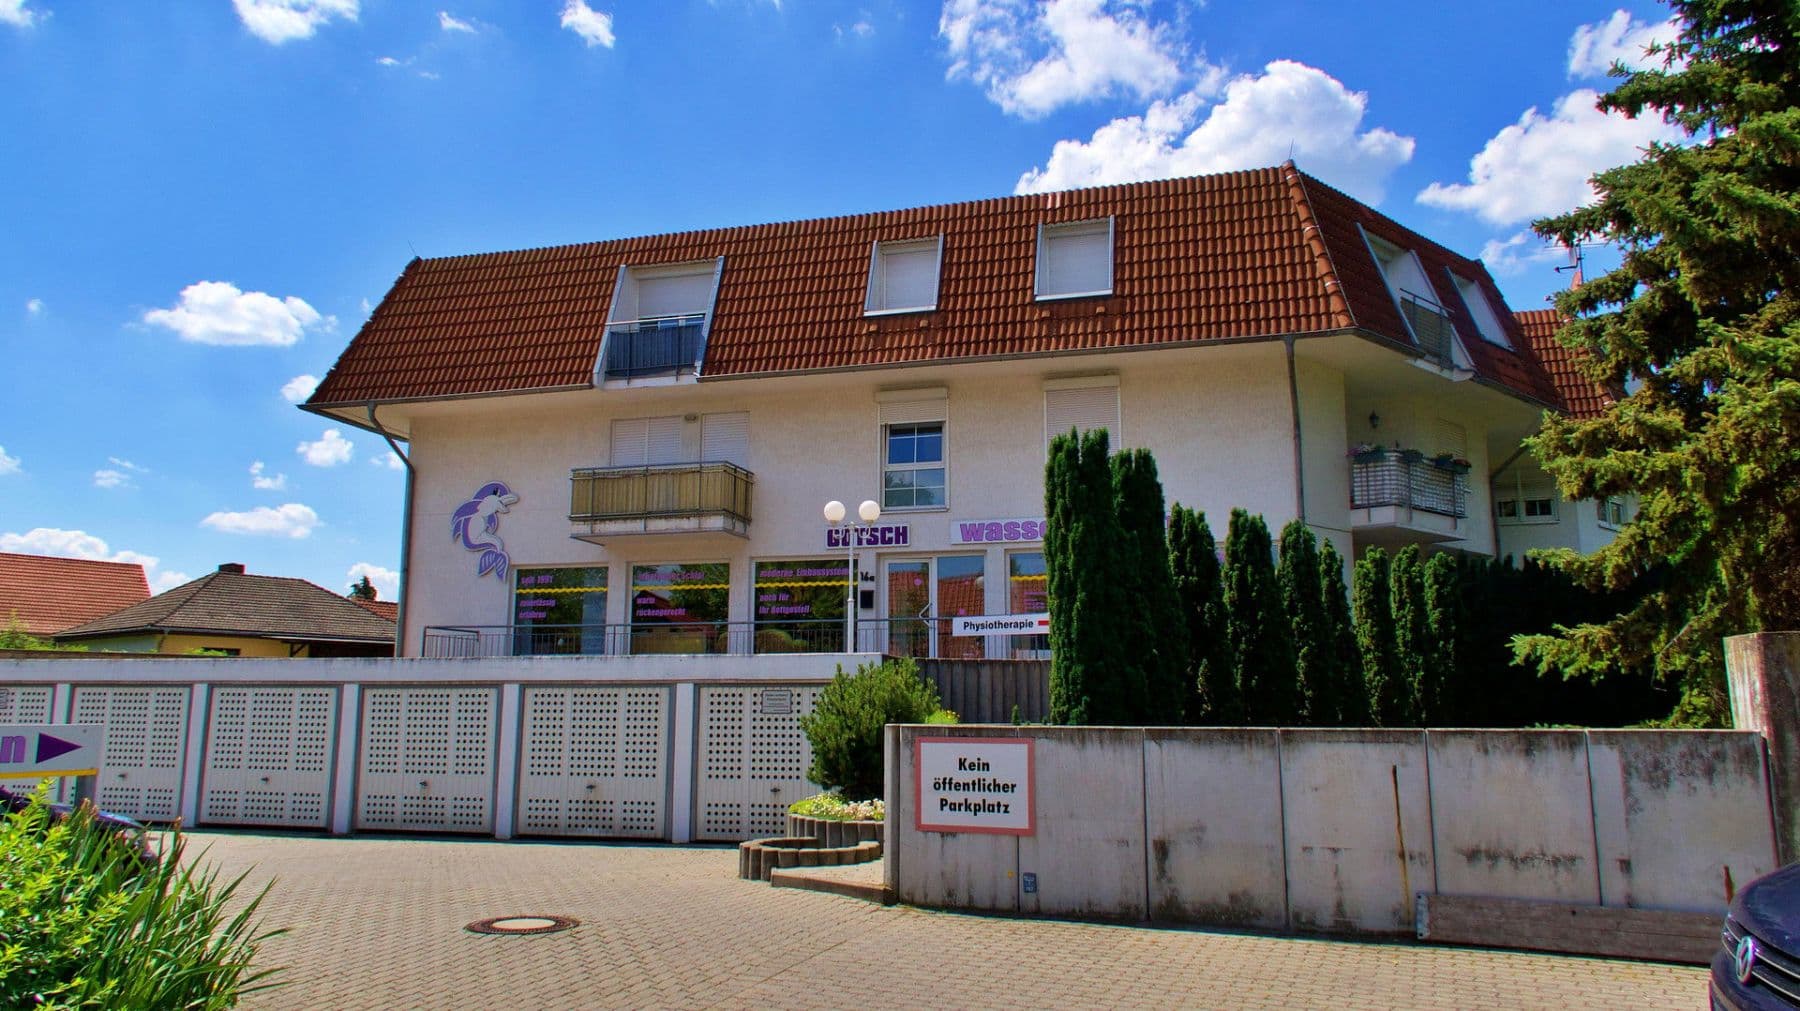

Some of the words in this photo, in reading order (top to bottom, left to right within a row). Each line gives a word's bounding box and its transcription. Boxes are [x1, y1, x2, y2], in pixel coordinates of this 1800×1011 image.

[860, 571, 875, 582] 16a
[963, 619, 1034, 632] Physiotherapie
[958, 757, 990, 772] Kein
[933, 777, 1017, 793] öffentlicher
[940, 798, 1010, 816] Parkplatz
